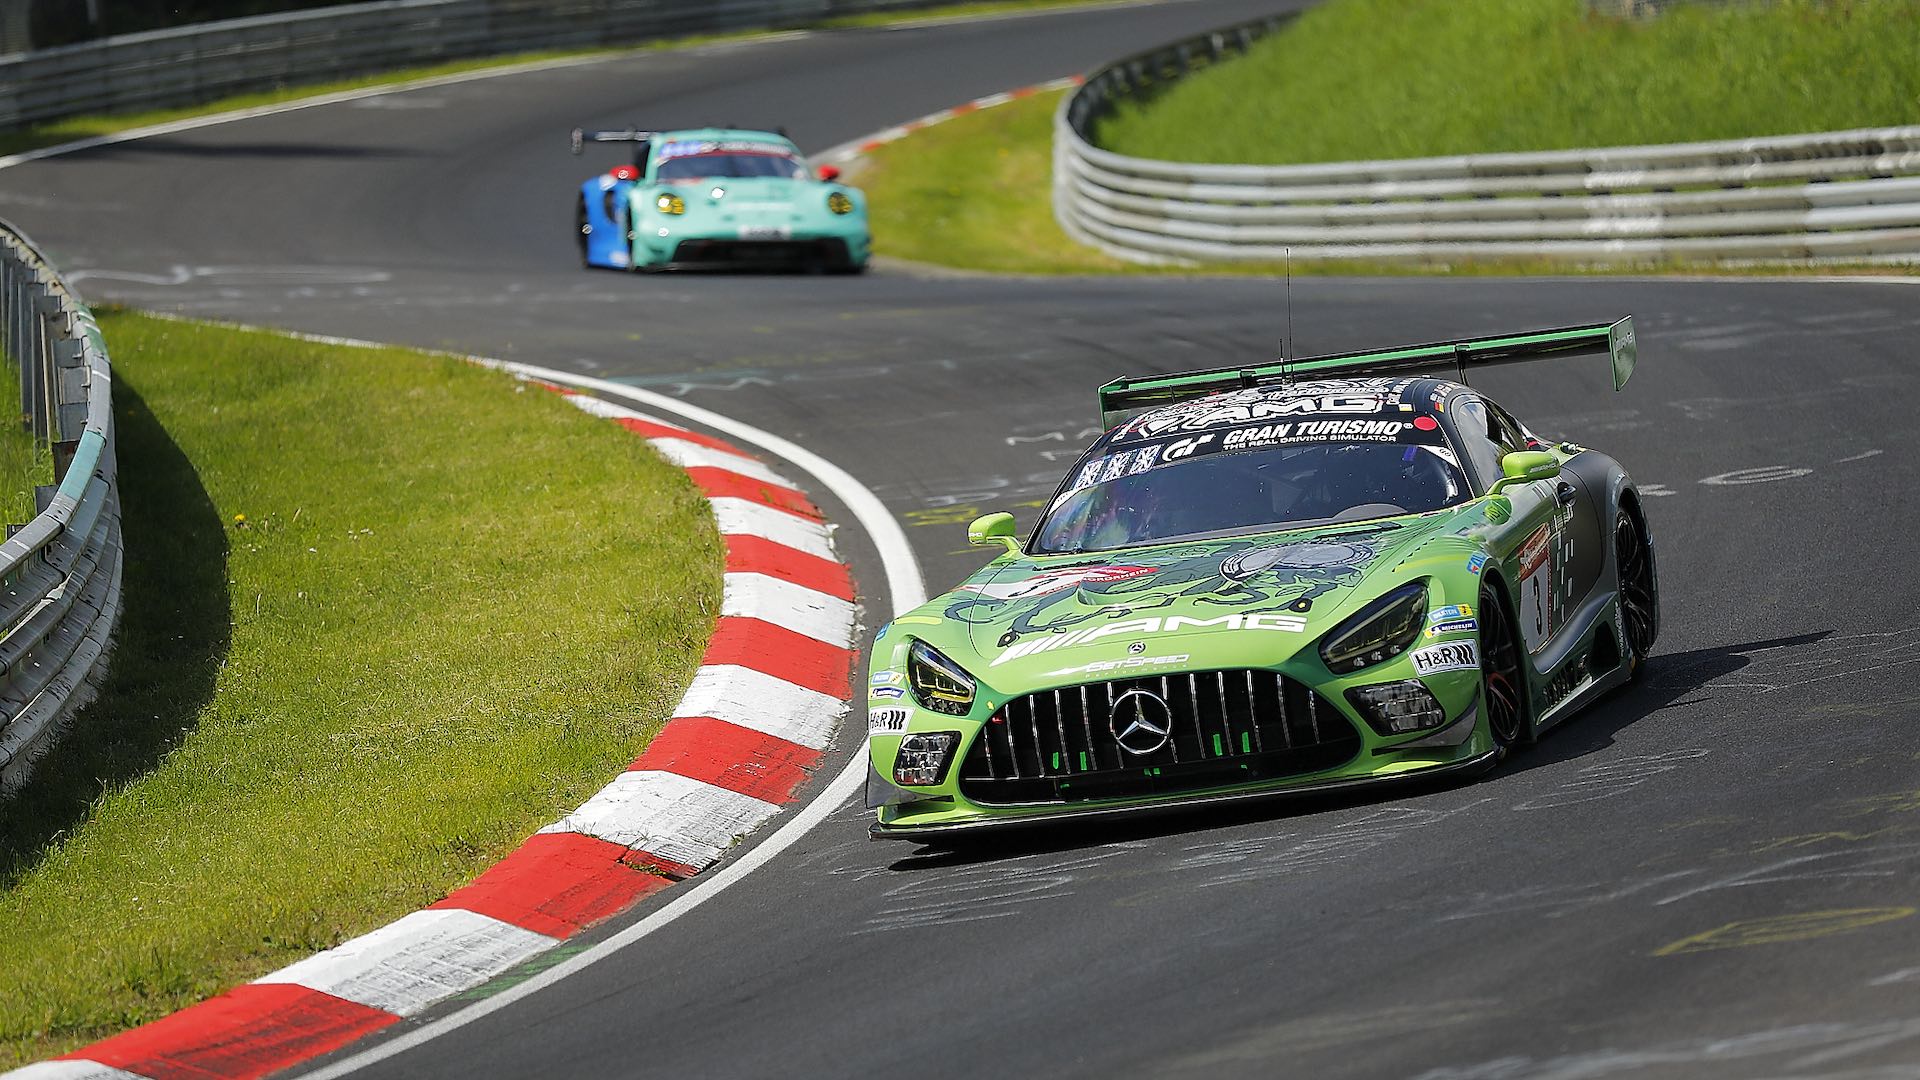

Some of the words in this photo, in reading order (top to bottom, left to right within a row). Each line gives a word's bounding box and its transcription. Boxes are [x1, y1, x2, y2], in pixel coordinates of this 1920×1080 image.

[1222, 443, 1246, 451] THE
[1248, 440, 1278, 448] REAL
[1280, 435, 1327, 443] DRIVING
[1330, 434, 1397, 442] SIMULATOR
[1223, 423, 1293, 444] GRAN
[1297, 419, 1402, 436] TURISMO
[1076, 613, 1308, 644] AMG
[1442, 622, 1473, 631] MICHELIN
[1415, 647, 1455, 669] H&R
